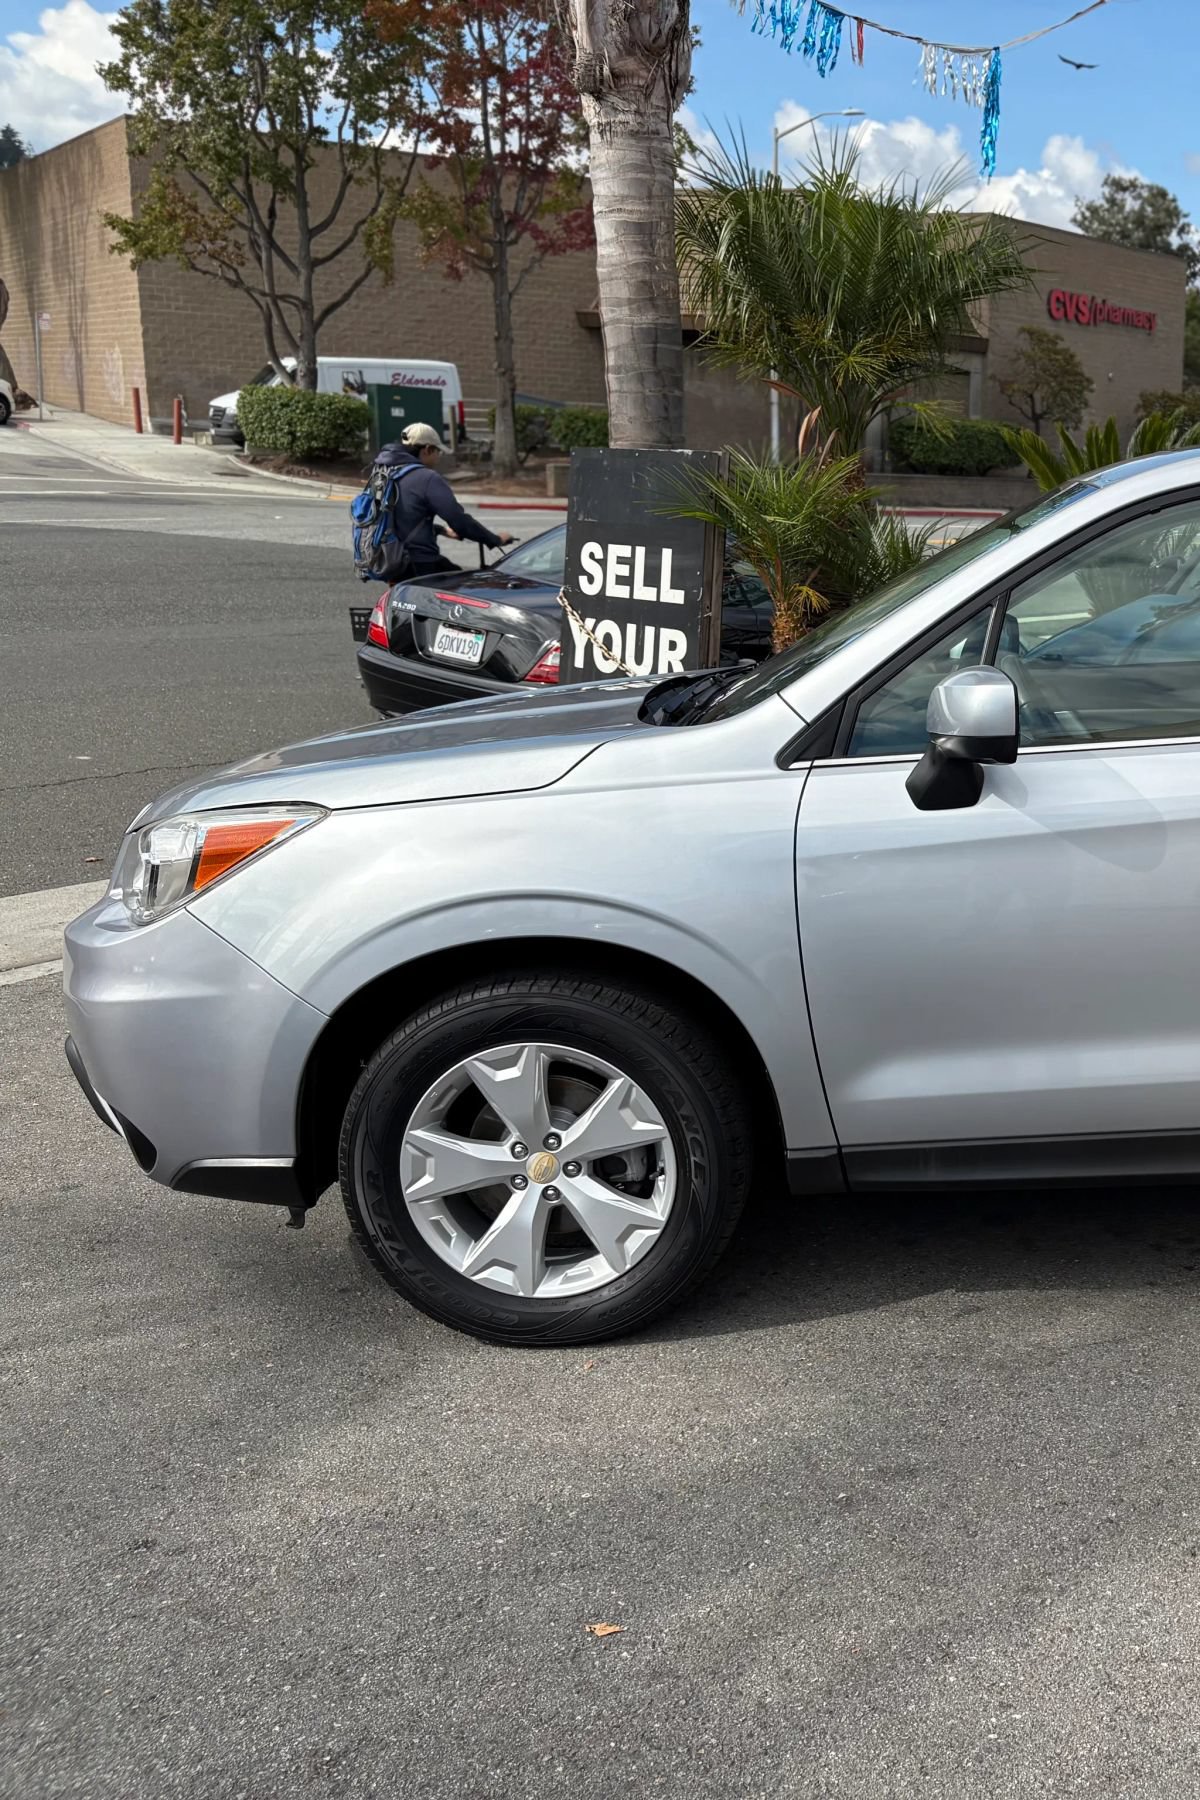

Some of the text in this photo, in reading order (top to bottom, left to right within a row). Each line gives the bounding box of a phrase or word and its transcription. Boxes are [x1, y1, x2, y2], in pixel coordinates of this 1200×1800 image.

[391, 372, 447, 386] Eldorado
[578, 541, 685, 604] SELL
[437, 633, 480, 657] 6DKV190
[567, 617, 688, 677] YOUR
